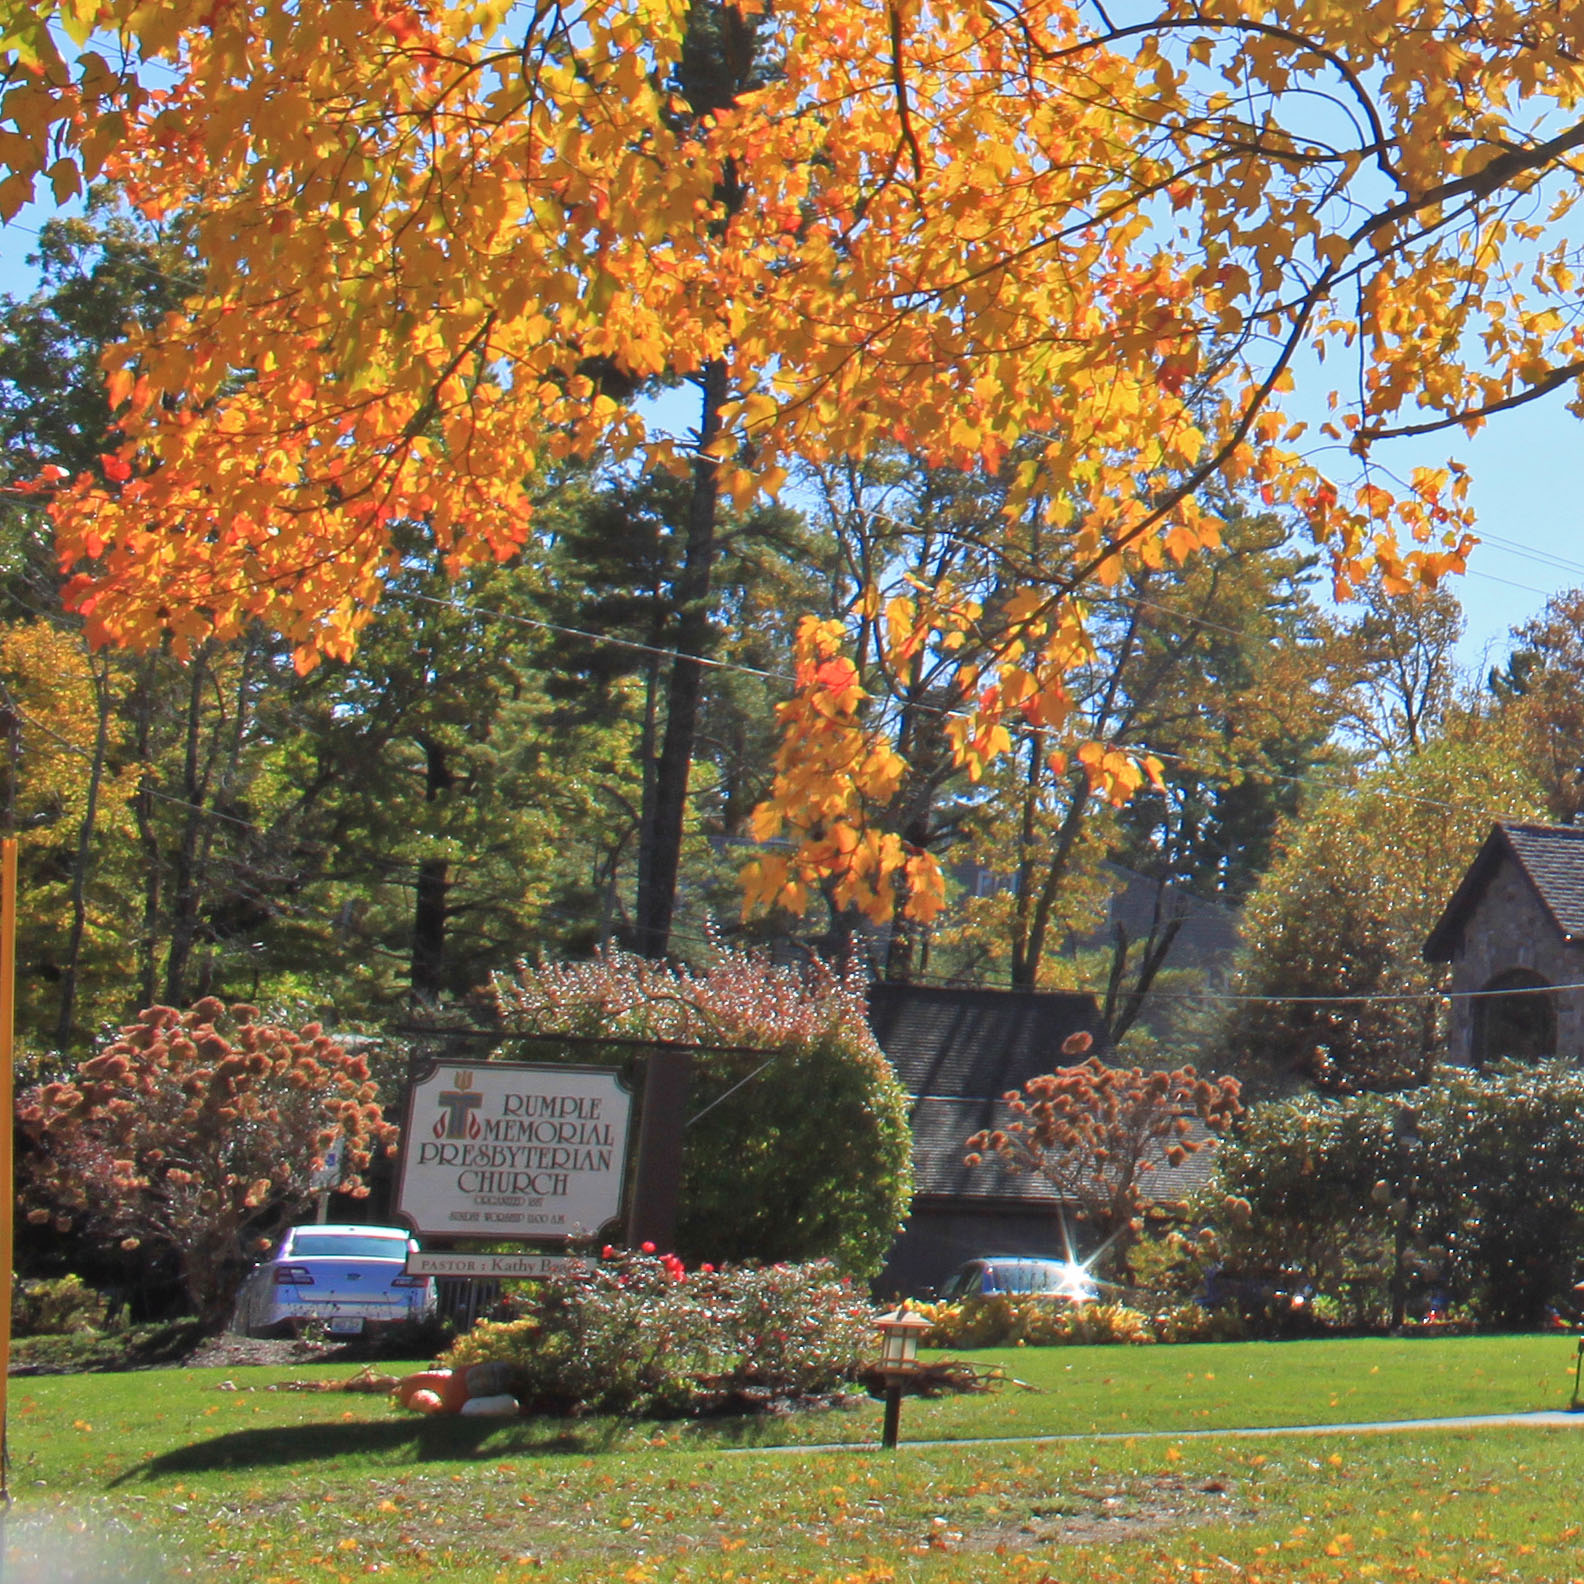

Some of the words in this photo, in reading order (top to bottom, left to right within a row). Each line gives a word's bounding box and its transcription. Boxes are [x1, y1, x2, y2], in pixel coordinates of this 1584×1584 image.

[501, 1093, 602, 1121] RUMPLE
[482, 1118, 615, 1147] MEMORIAL
[417, 1142, 614, 1172] PRESBYTERIAN
[457, 1169, 569, 1196] CHURCH
[483, 1212, 524, 1224] WORSHIP
[421, 1259, 476, 1272] PASTOR
[491, 1257, 534, 1275] Kathy
